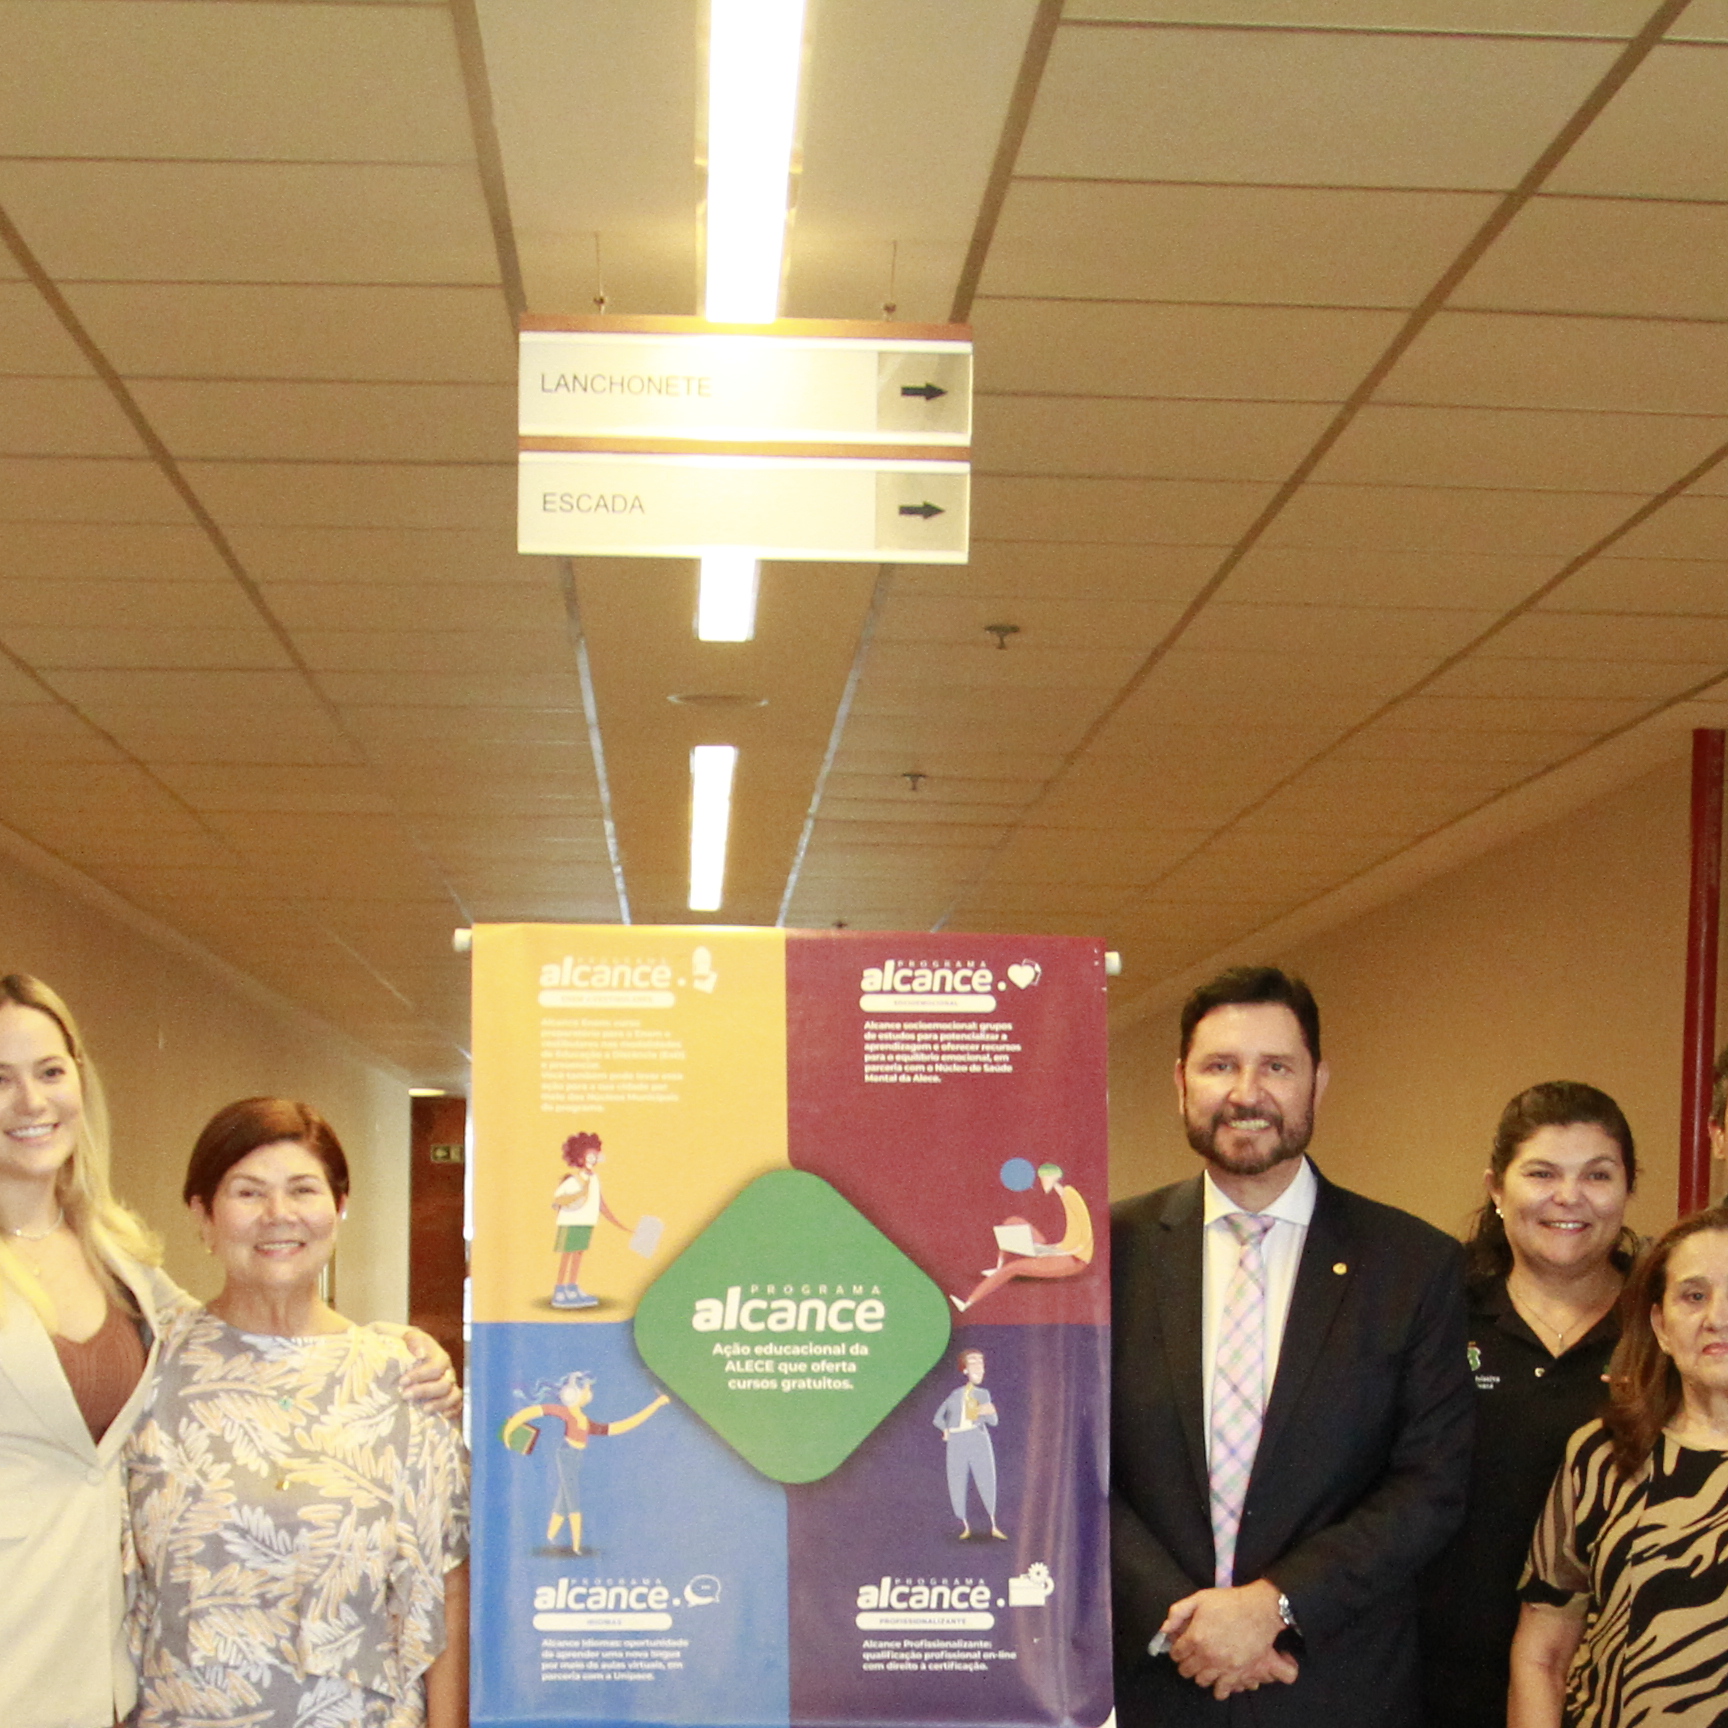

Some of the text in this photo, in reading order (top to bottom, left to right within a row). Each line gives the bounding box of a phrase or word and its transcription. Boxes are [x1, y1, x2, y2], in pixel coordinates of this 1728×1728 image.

[540, 373, 712, 399] LANCHONETE
[542, 492, 646, 515] ESCADA
[898, 960, 987, 968] PROGRAMA
[864, 1020, 1012, 1033] Alcance socioemocional: grupos
[864, 1031, 876, 1041] de
[878, 1031, 915, 1041] estudos
[917, 1033, 938, 1042] para
[940, 1031, 999, 1042] potencializar
[864, 1042, 931, 1053] aprendizagem
[941, 1042, 979, 1051] oferecer
[981, 1044, 1021, 1052] recursos
[750, 1284, 880, 1295] PROGRAMA
[692, 1286, 886, 1332] alcance
[712, 1343, 869, 1357] Ação educacional da
[725, 1360, 857, 1375] ALECE que oferta
[728, 1378, 854, 1392] cursos gratuitos.
[863, 1639, 992, 1649] Alcance Profissionalizante:
[863, 1650, 1017, 1661] qualificação profissional on-line
[886, 1661, 919, 1670] direito
[928, 1661, 988, 1672] certificação.
